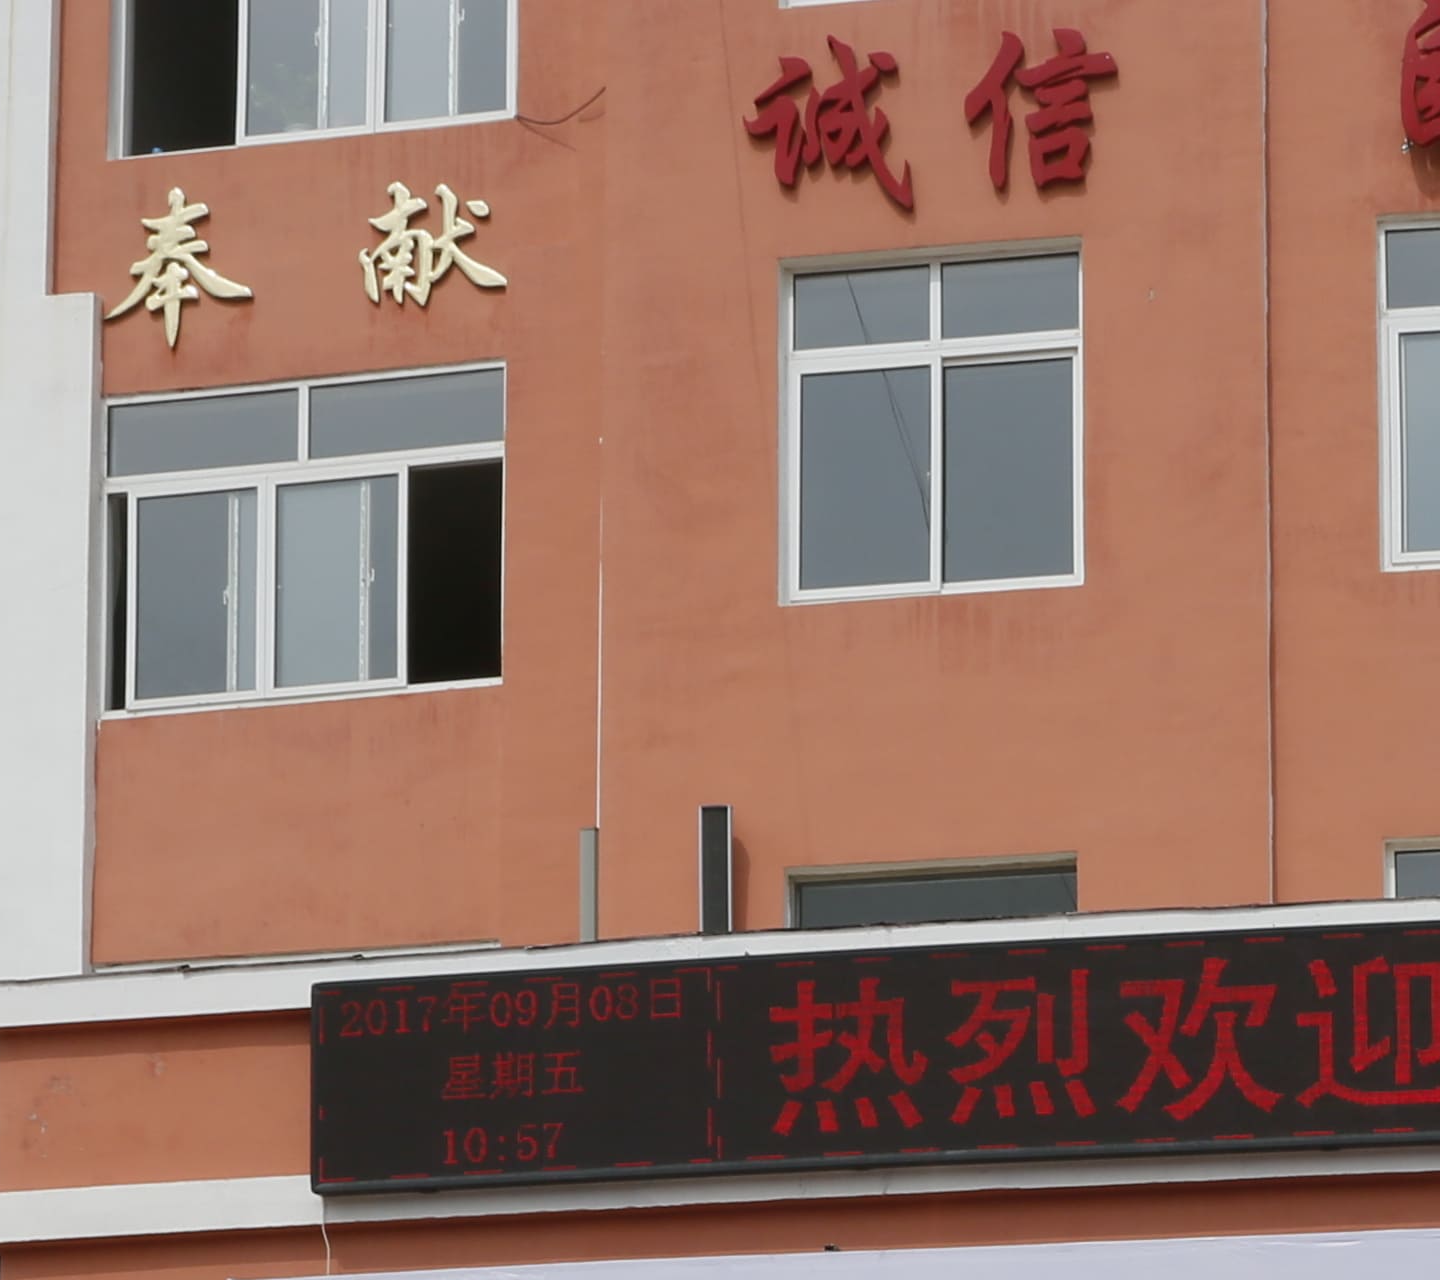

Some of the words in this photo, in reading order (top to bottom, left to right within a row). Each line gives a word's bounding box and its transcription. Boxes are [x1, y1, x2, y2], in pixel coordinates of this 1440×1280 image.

[742, 28, 1118, 213] 诚信
[104, 182, 508, 348] 奉献
[339, 976, 683, 1039] 2017年09月08日
[441, 1051, 584, 1101] 星期五
[442, 1123, 564, 1165] 10:57
